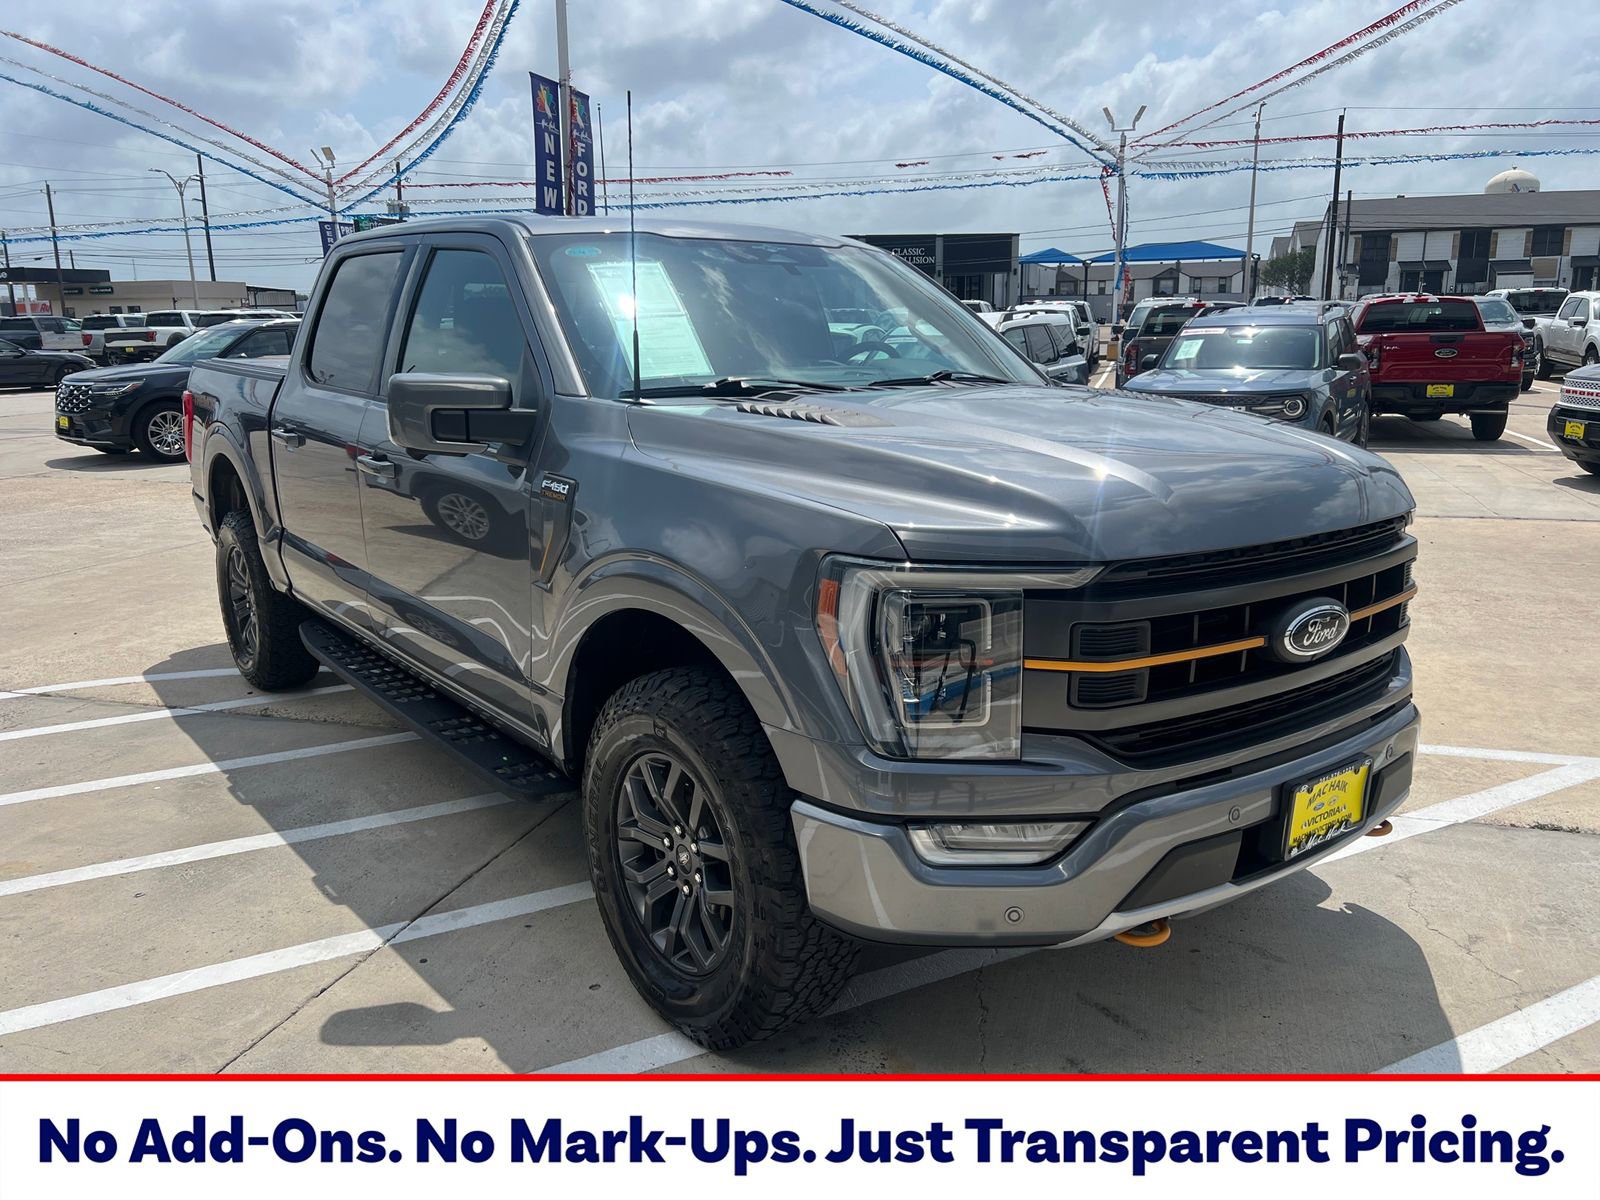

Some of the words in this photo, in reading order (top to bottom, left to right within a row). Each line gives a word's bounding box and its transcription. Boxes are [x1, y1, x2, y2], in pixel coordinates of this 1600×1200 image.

[544, 132, 558, 209] NEW
[576, 141, 588, 216] FORD
[891, 247, 925, 256] CLASSIC
[1303, 616, 1338, 646] Ford
